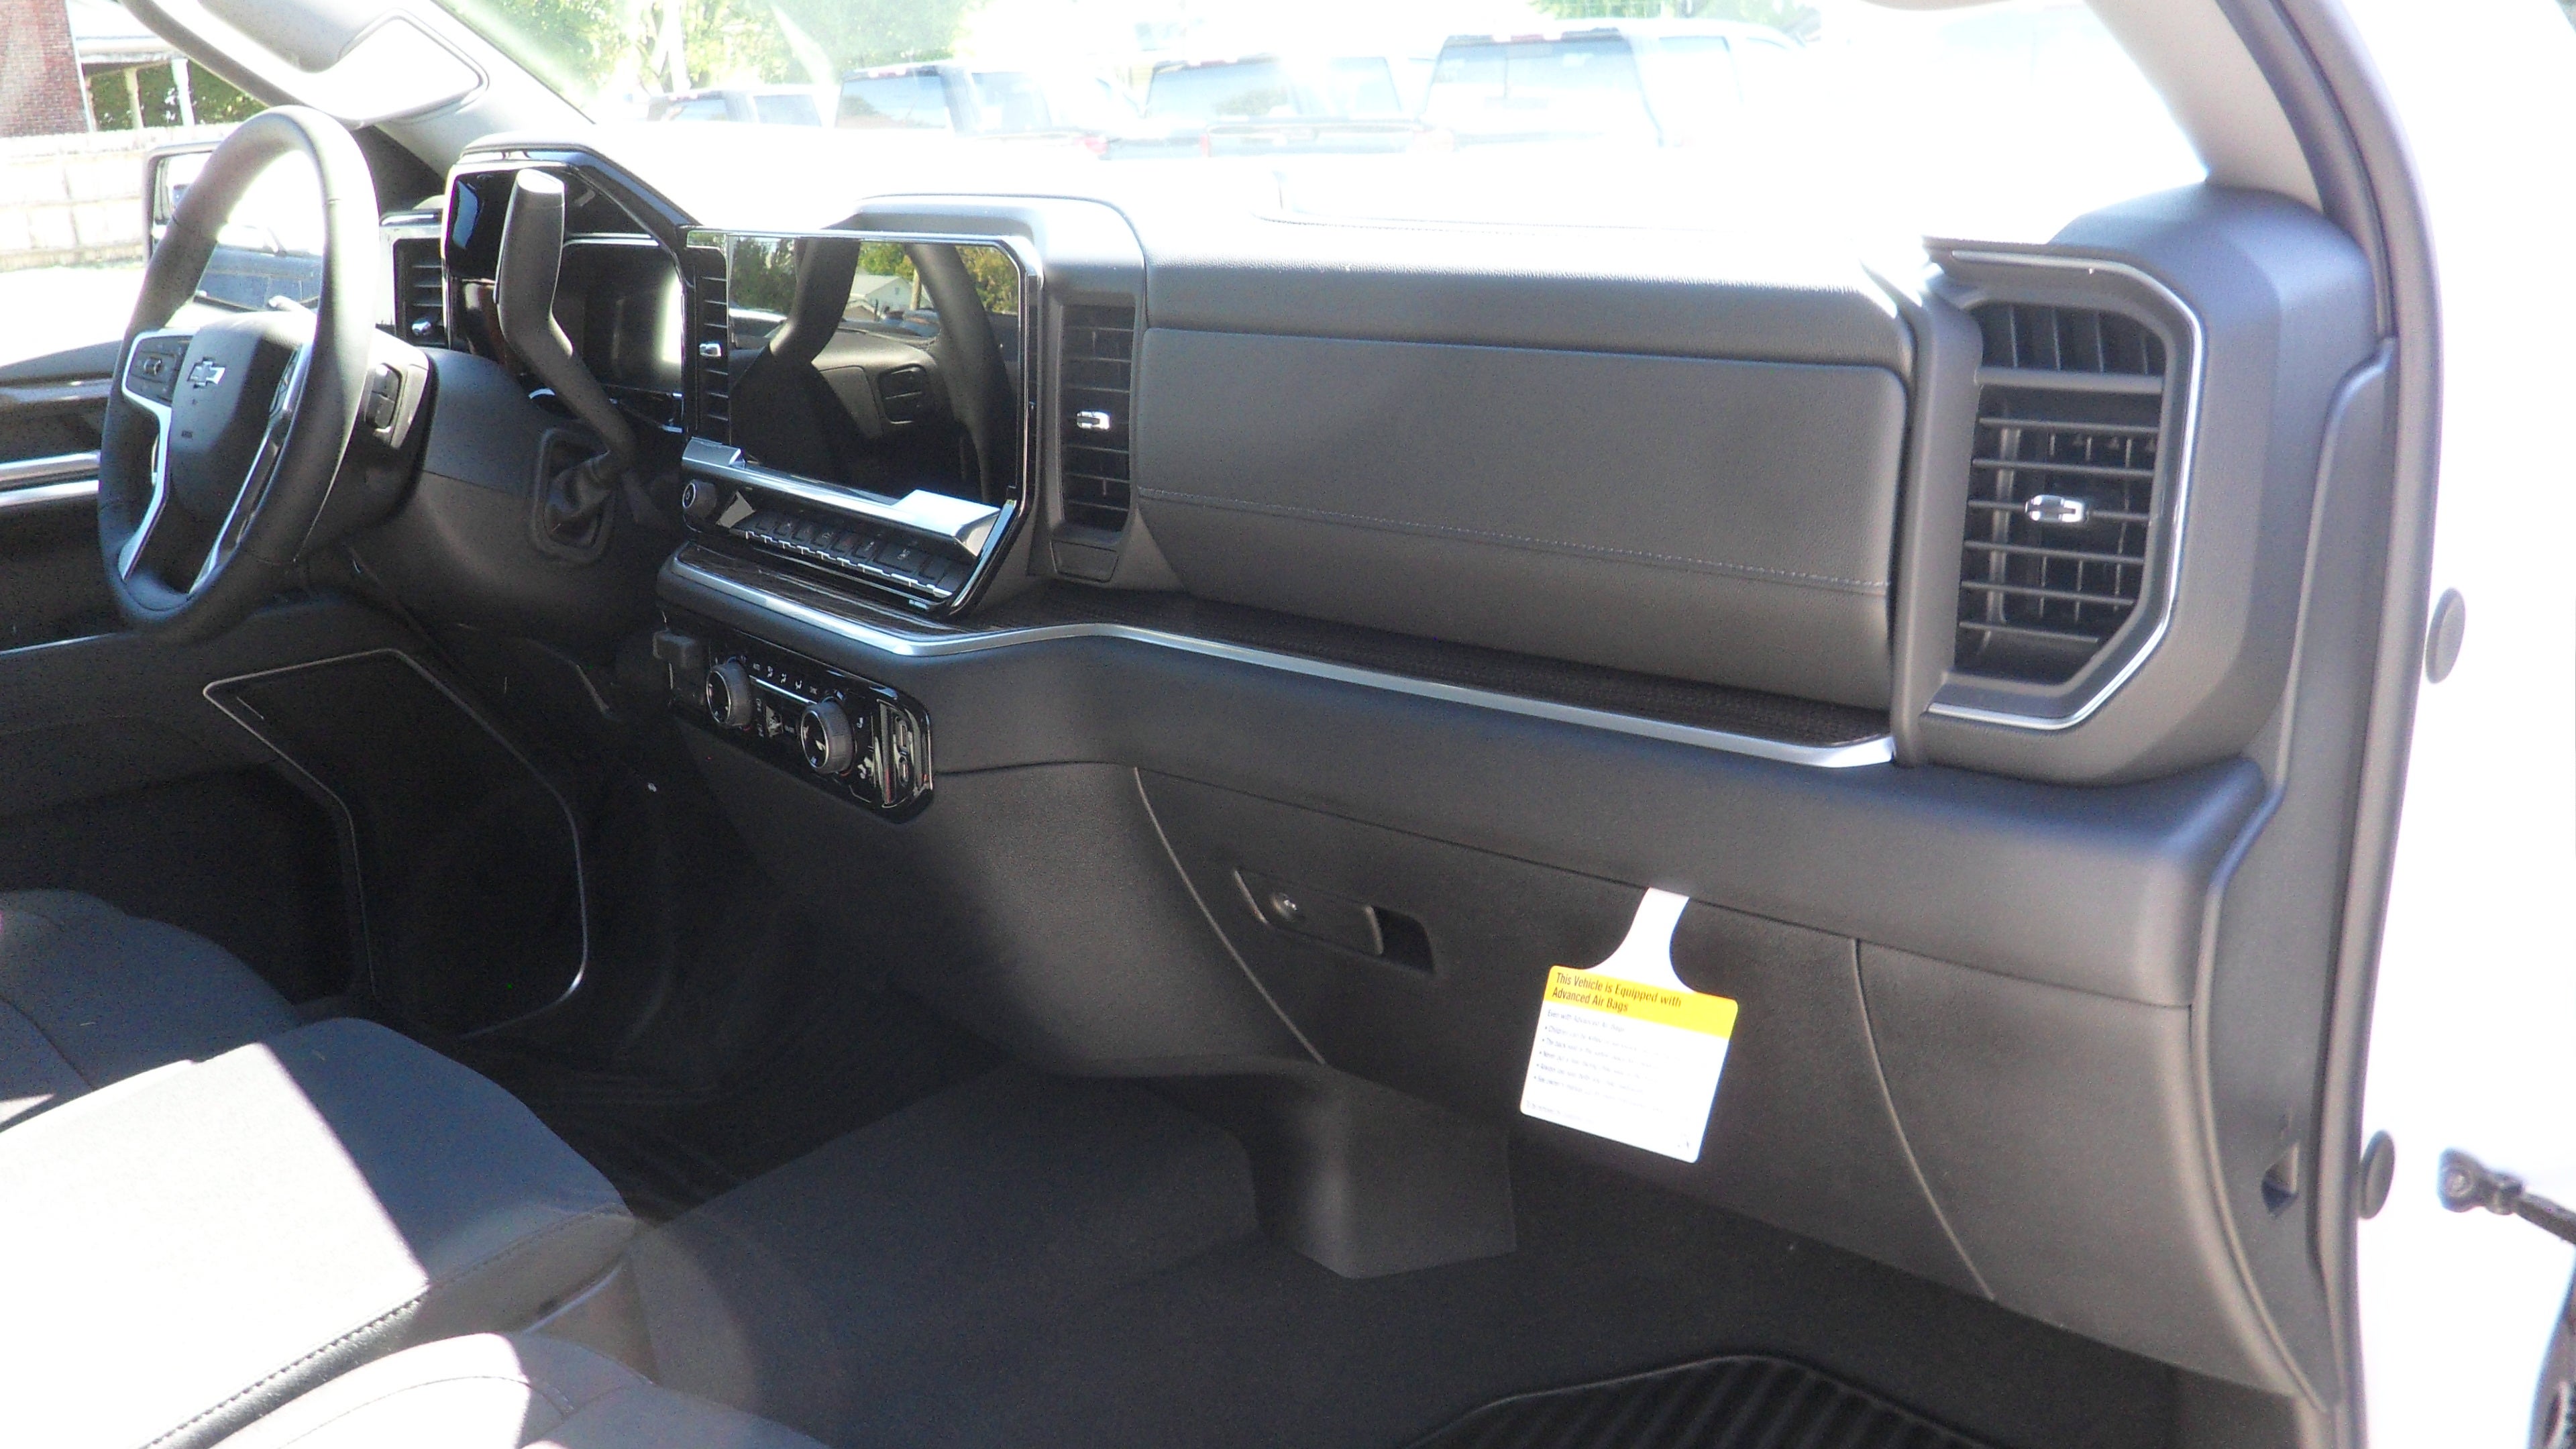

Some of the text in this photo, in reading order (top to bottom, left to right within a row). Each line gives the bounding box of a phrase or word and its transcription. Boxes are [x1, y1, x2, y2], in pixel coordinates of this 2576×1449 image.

[1552, 987, 1629, 1013] Advanced Air Bags
[1556, 972, 1682, 1008] This Vehicle is Equipped with
